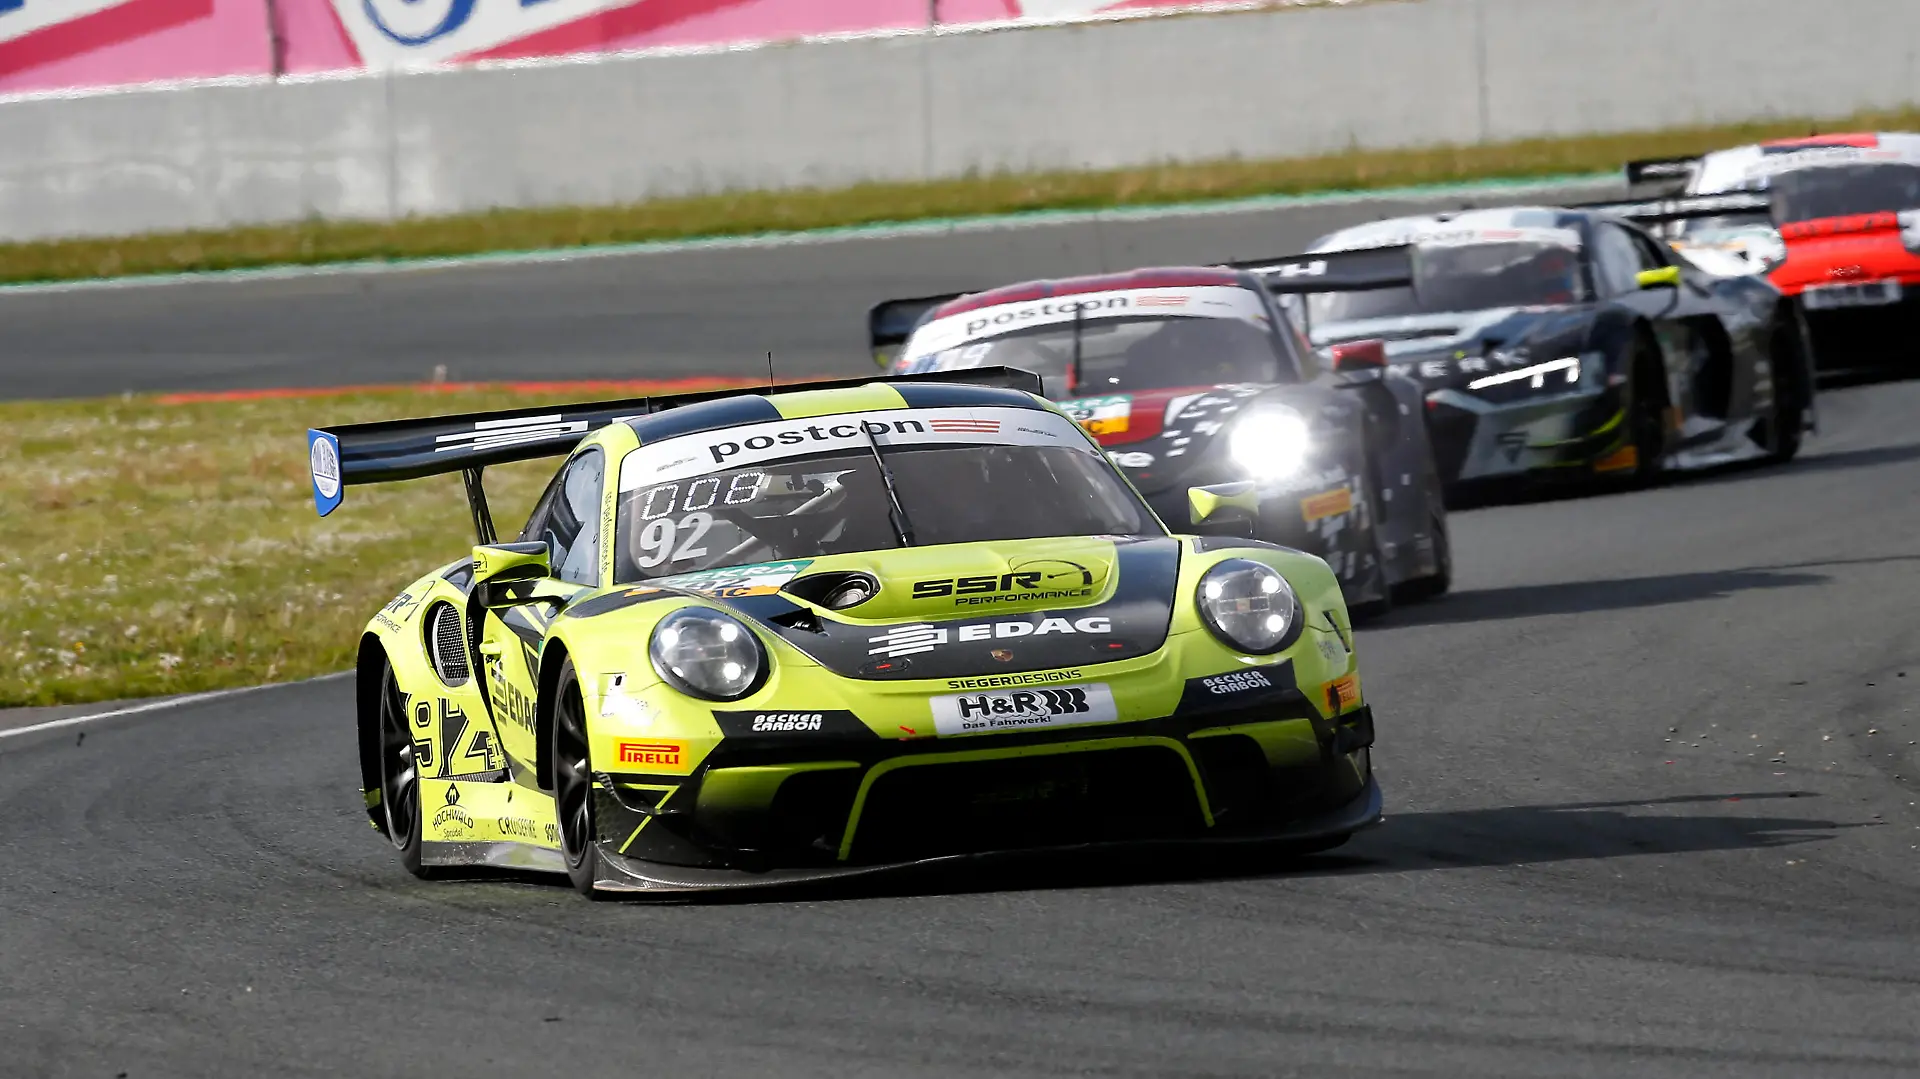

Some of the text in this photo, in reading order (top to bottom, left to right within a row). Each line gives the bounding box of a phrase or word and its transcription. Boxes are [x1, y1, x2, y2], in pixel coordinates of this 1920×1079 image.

[965, 295, 1129, 335] postcon
[708, 419, 926, 464] postcon
[640, 472, 767, 521] 008
[638, 513, 713, 569] 92
[912, 571, 1042, 600] SSR
[954, 588, 1093, 606] PERFORMANCE
[958, 616, 1112, 643] EDAG
[947, 669, 1082, 690] SIEGERDESIGNS
[1203, 670, 1265, 688] BECKER
[1210, 677, 1272, 695] CARBON
[957, 690, 1043, 720] H&R
[751, 721, 823, 732] CARBON
[753, 713, 823, 724] BECKER
[962, 715, 1052, 730] Das Fahrwerk!
[619, 742, 681, 765] PIRELLI
[432, 808, 475, 831] HOCHWALD
